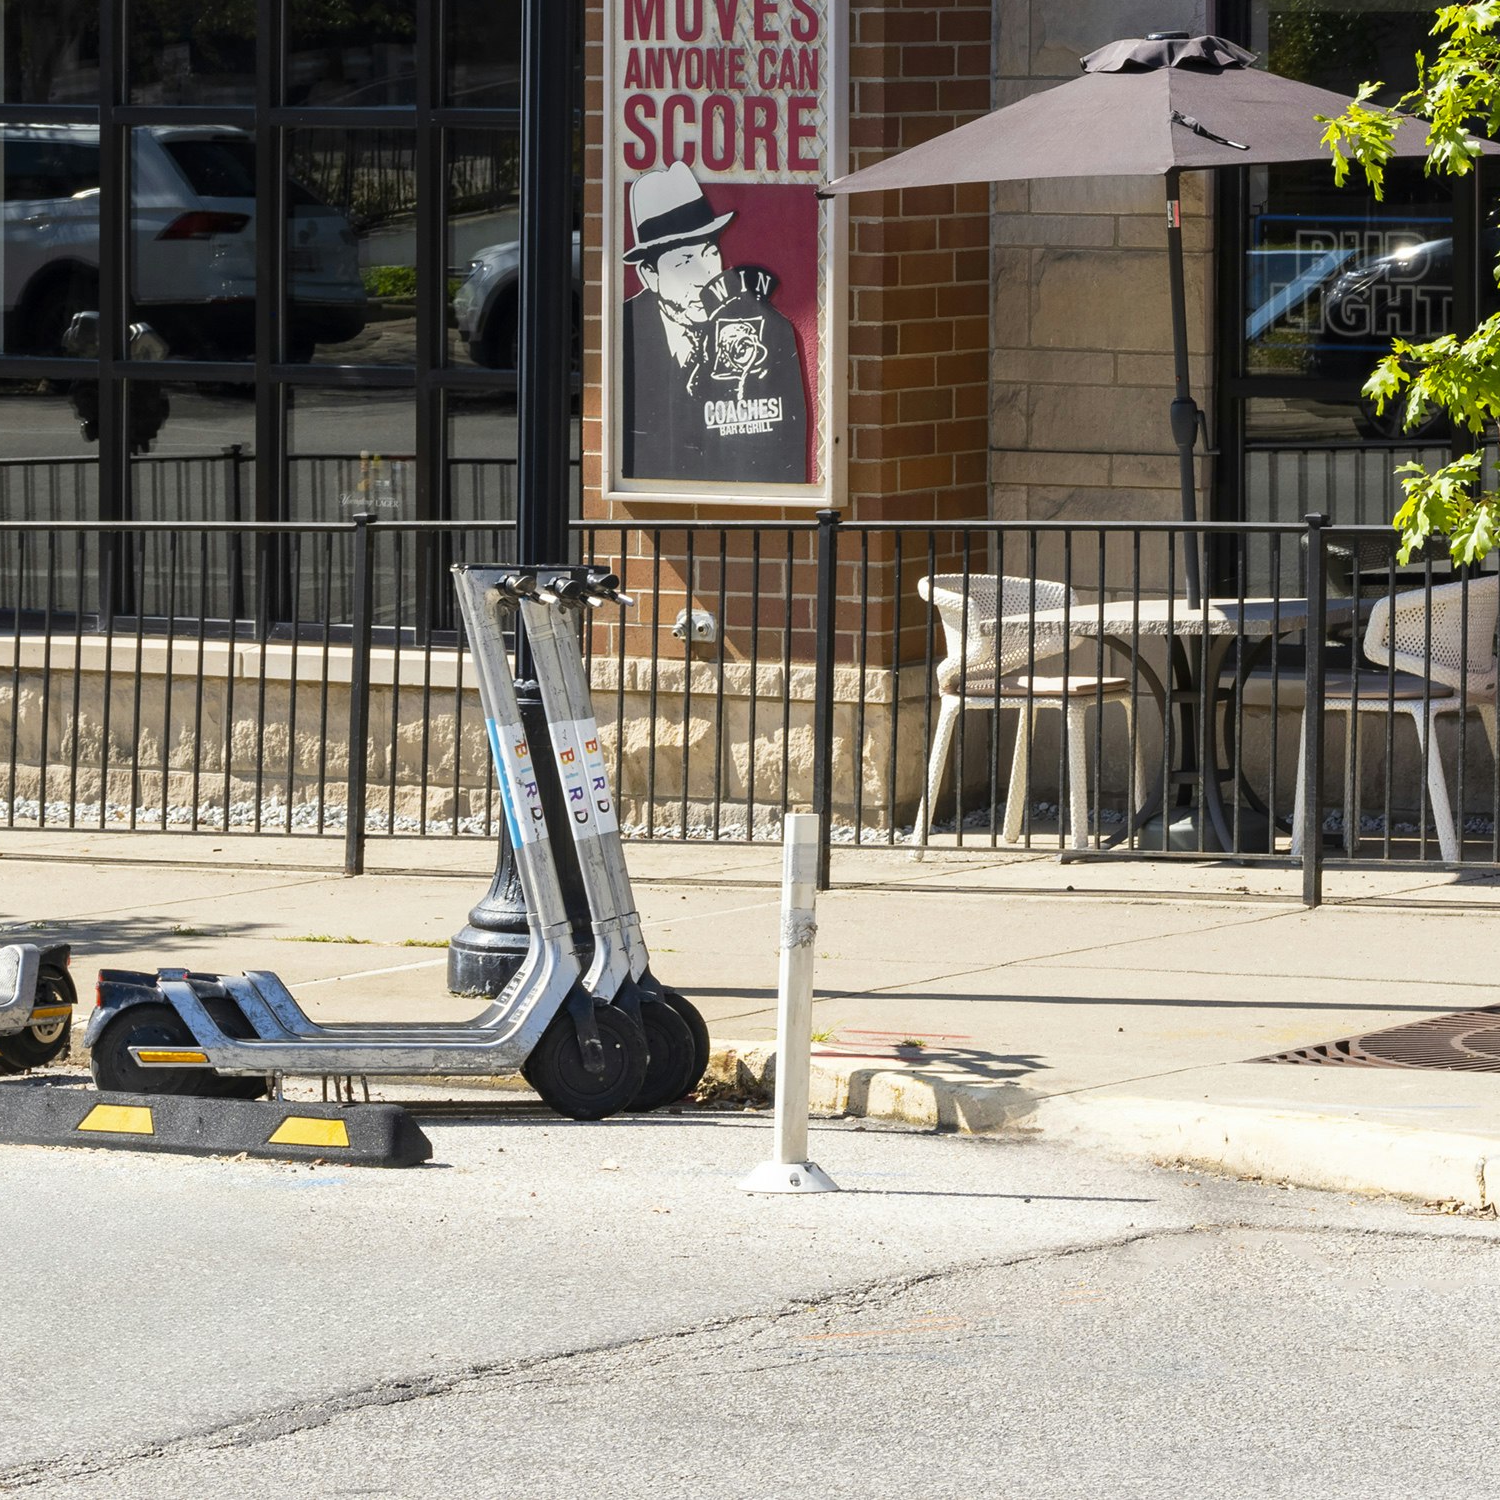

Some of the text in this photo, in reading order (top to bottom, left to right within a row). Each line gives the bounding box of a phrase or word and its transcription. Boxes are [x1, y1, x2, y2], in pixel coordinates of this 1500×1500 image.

[624, 47, 819, 90] ANYONE CAN
[624, 94, 819, 171] SCORE
[1296, 230, 1431, 282] BUD
[709, 271, 771, 302] WIN
[1269, 282, 1453, 336] LIGHT
[704, 398, 779, 426] COACHES
[719, 420, 773, 436] BAR & GRILL
[514, 740, 543, 821] BIRD
[560, 747, 589, 824] BIRD
[585, 737, 610, 814] BIRD
